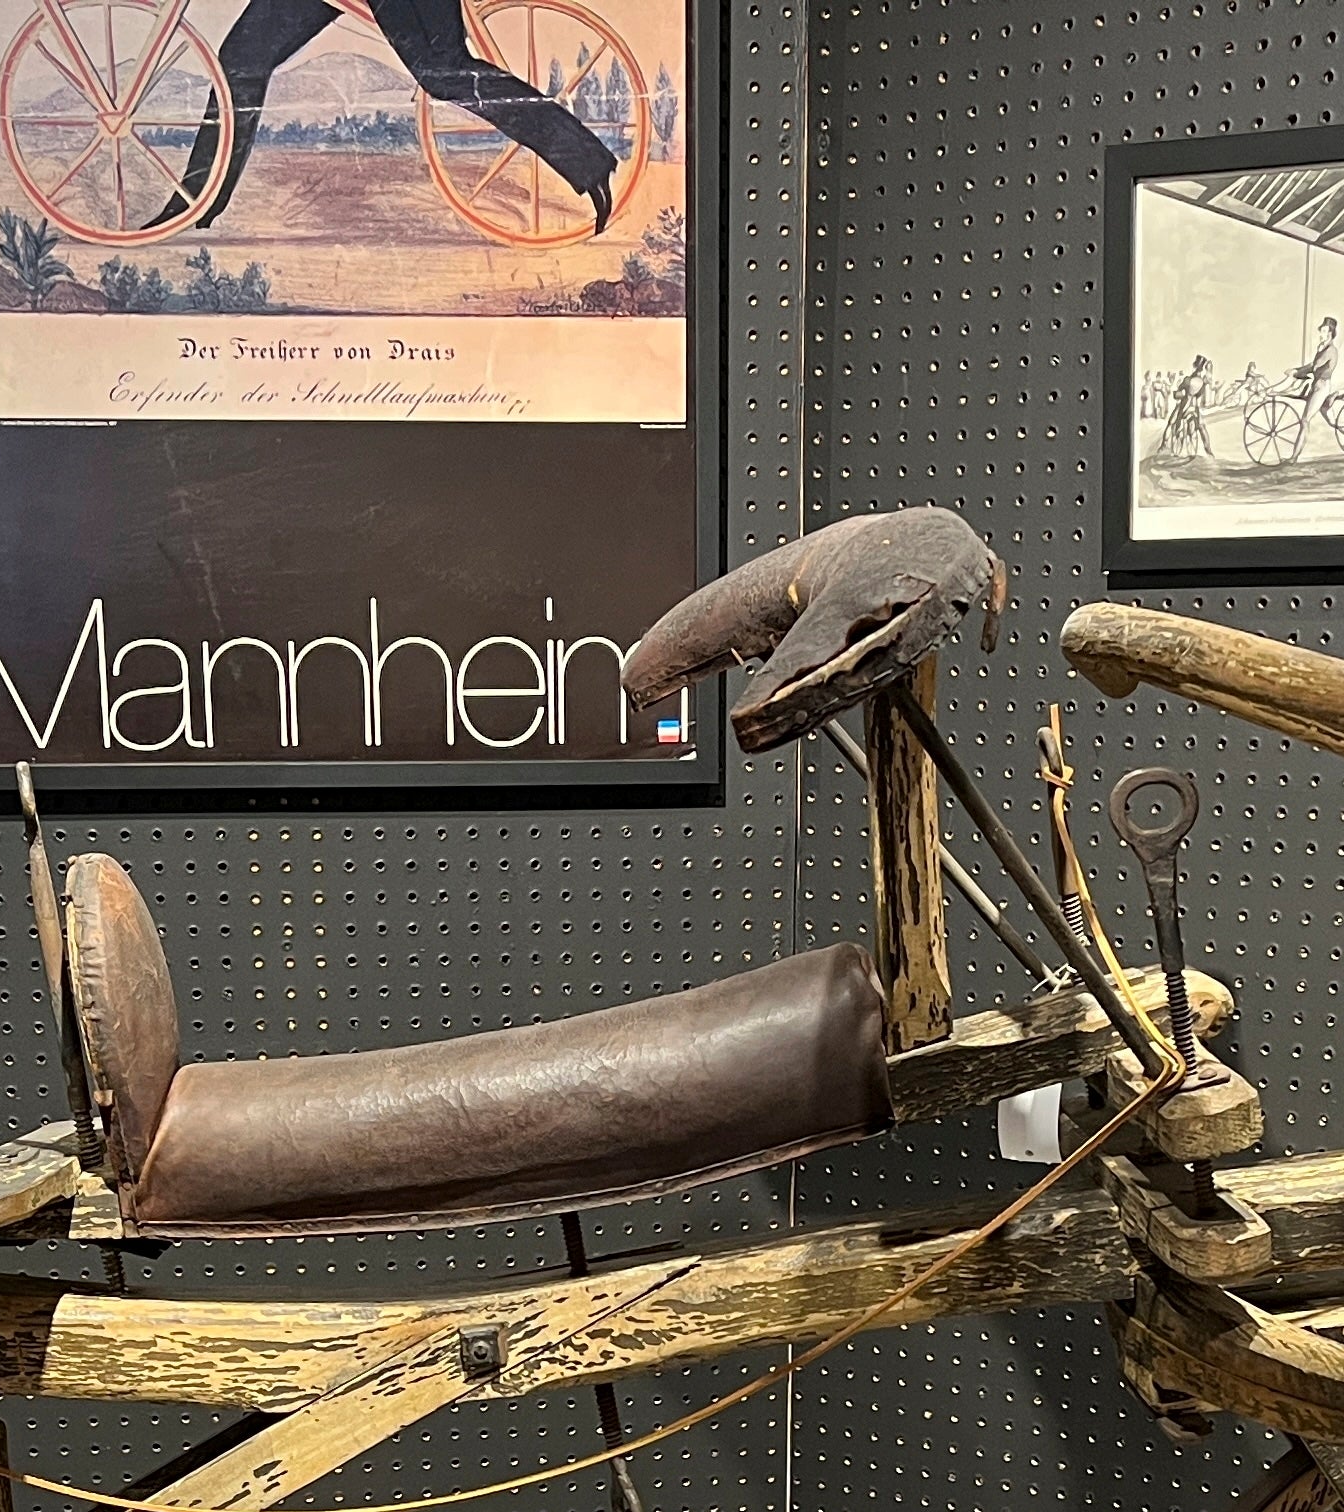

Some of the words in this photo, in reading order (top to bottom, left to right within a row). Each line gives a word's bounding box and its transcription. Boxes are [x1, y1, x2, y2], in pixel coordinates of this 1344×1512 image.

[178, 337, 220, 360] Der
[230, 338, 320, 363] Freiherr
[334, 344, 372, 360] von
[387, 338, 456, 360] Drais
[109, 371, 224, 412] Erfinder
[242, 382, 279, 402] der
